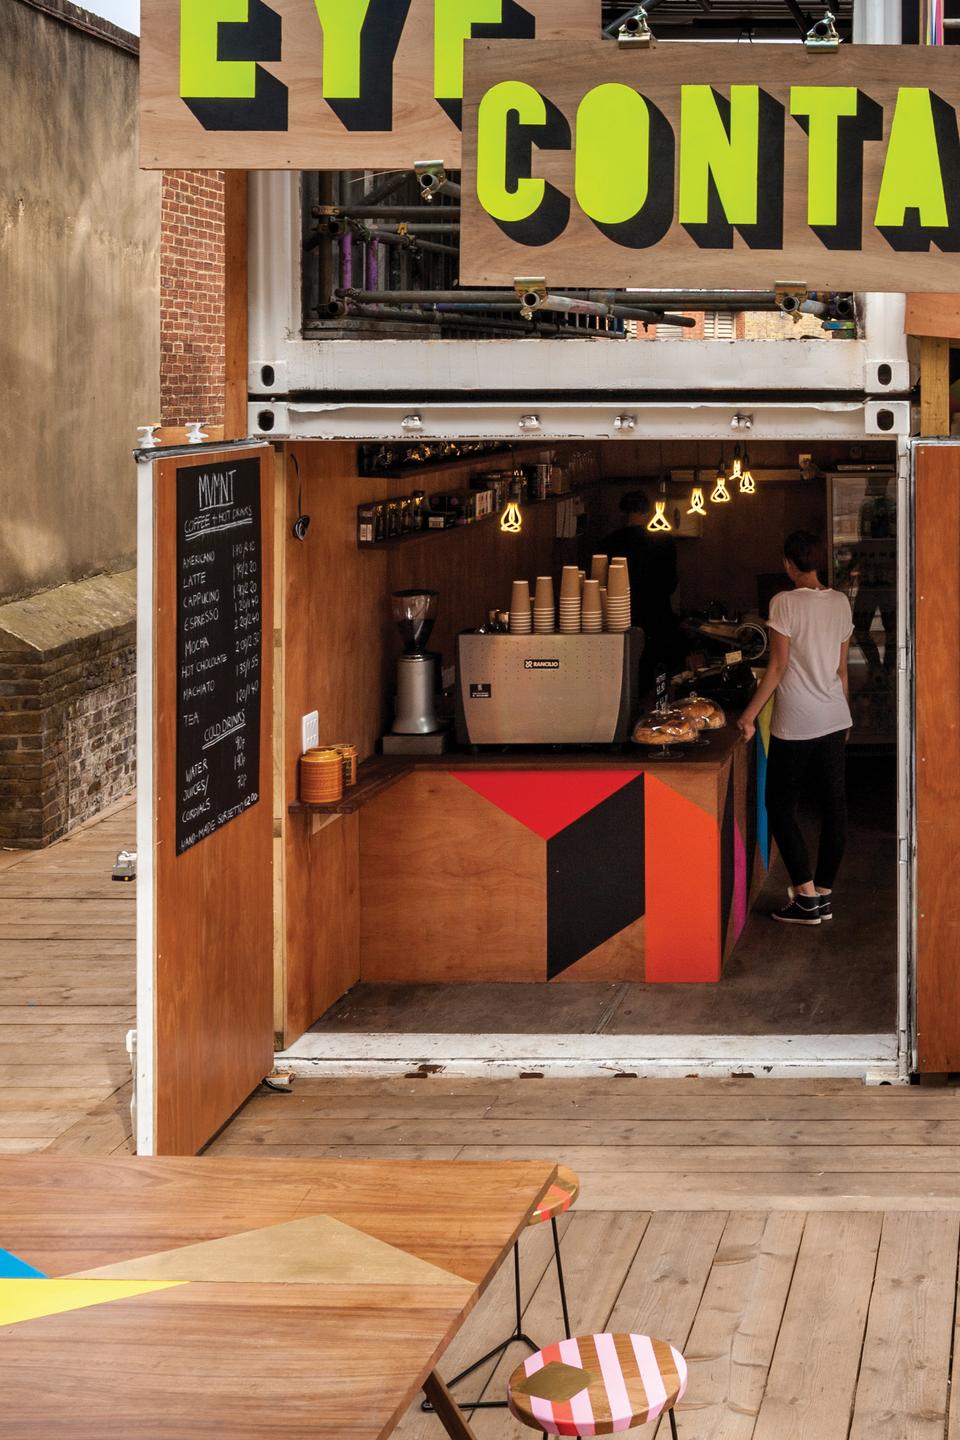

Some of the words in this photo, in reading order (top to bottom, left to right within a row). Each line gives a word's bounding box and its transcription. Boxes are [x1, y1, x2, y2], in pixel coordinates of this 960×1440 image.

[198, 469, 237, 509] MVMNT
[184, 513, 210, 533] COFFEE
[183, 551, 215, 568] AMERICANO
[183, 571, 206, 588] LATTE
[184, 608, 219, 631] ESPRESSO
[185, 637, 209, 656] MOCHA
[182, 664, 194, 678] HOT
[183, 712, 199, 727] TEA
[204, 723, 221, 741] COLD
[185, 758, 208, 783] WATER
